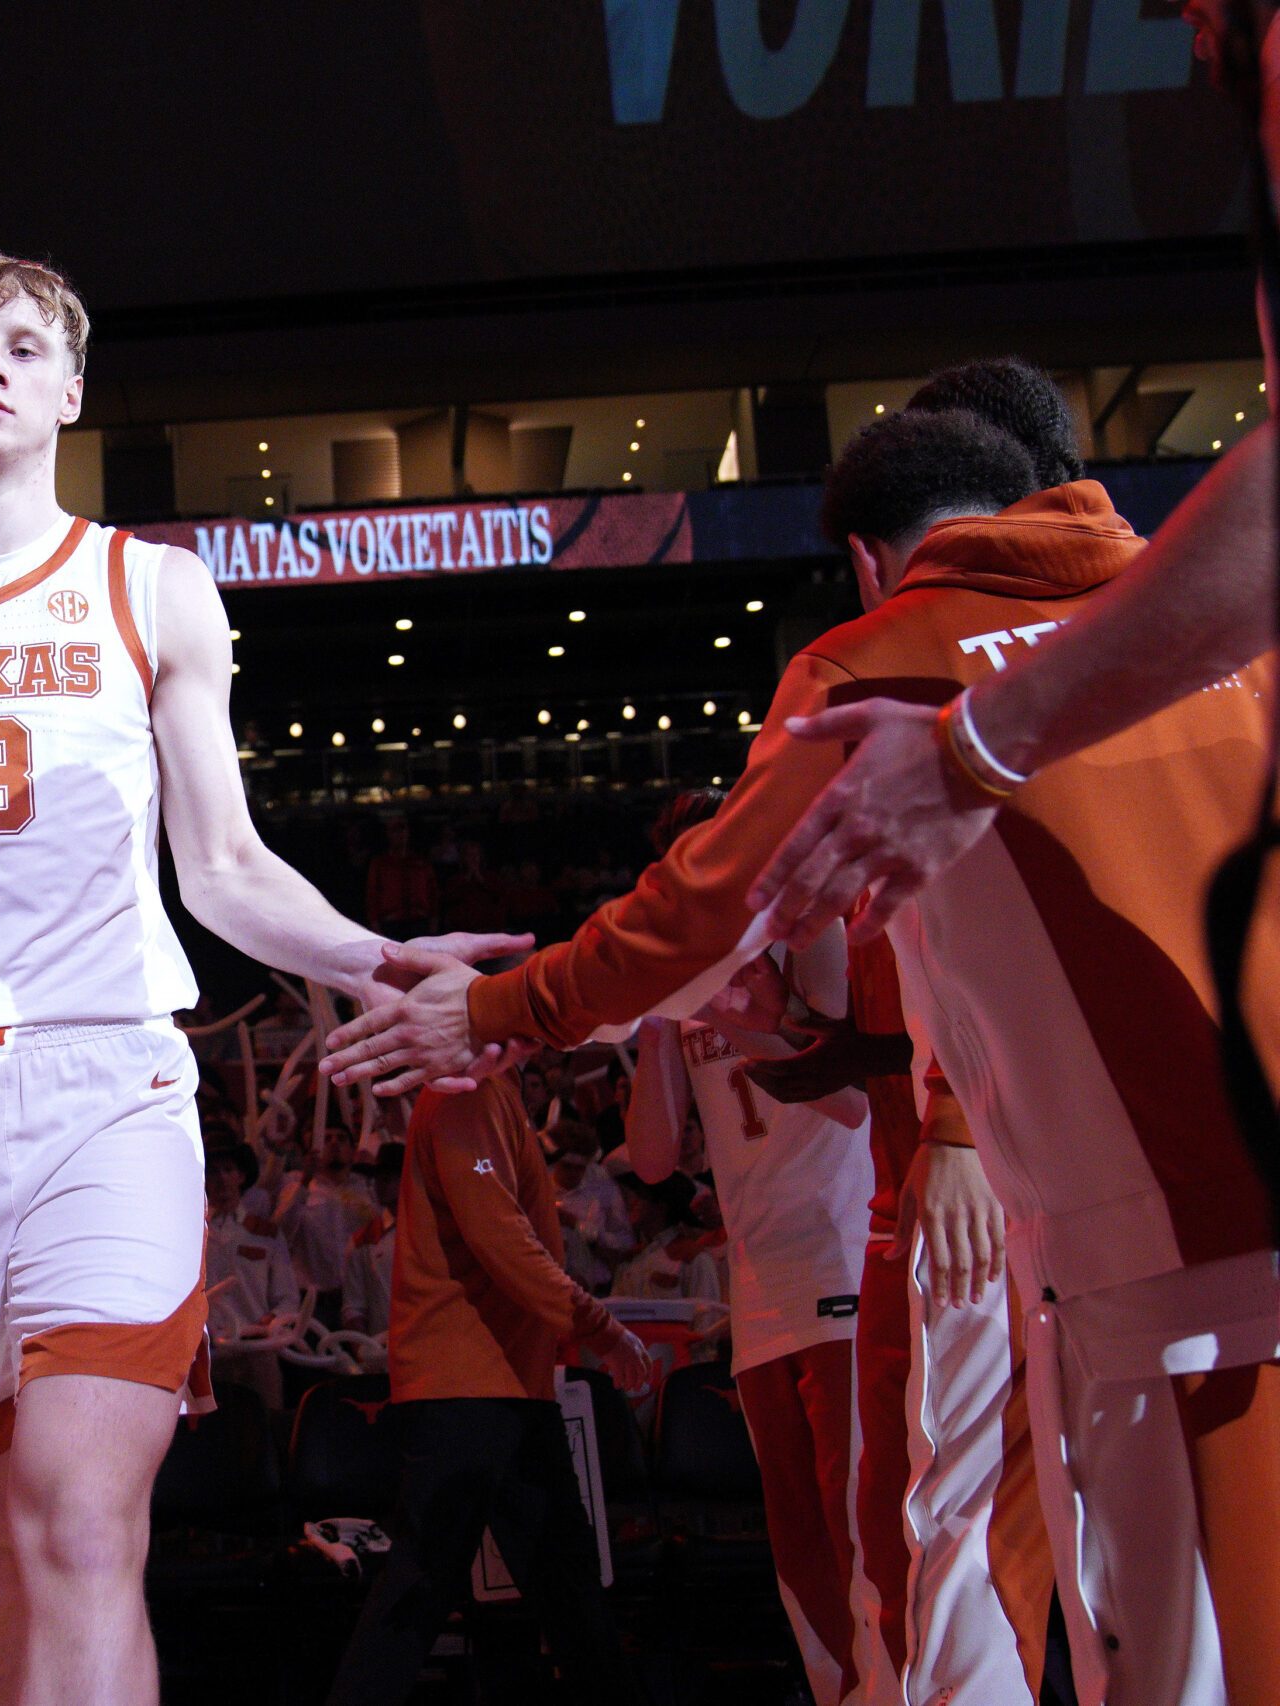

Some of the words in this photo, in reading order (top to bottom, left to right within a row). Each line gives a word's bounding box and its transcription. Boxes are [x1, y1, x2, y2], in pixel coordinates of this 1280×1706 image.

[194, 519, 321, 584] MATAS
[324, 505, 554, 577] VOKIETAITIS
[50, 591, 88, 623] SEC
[727, 1065, 768, 1141] 1
